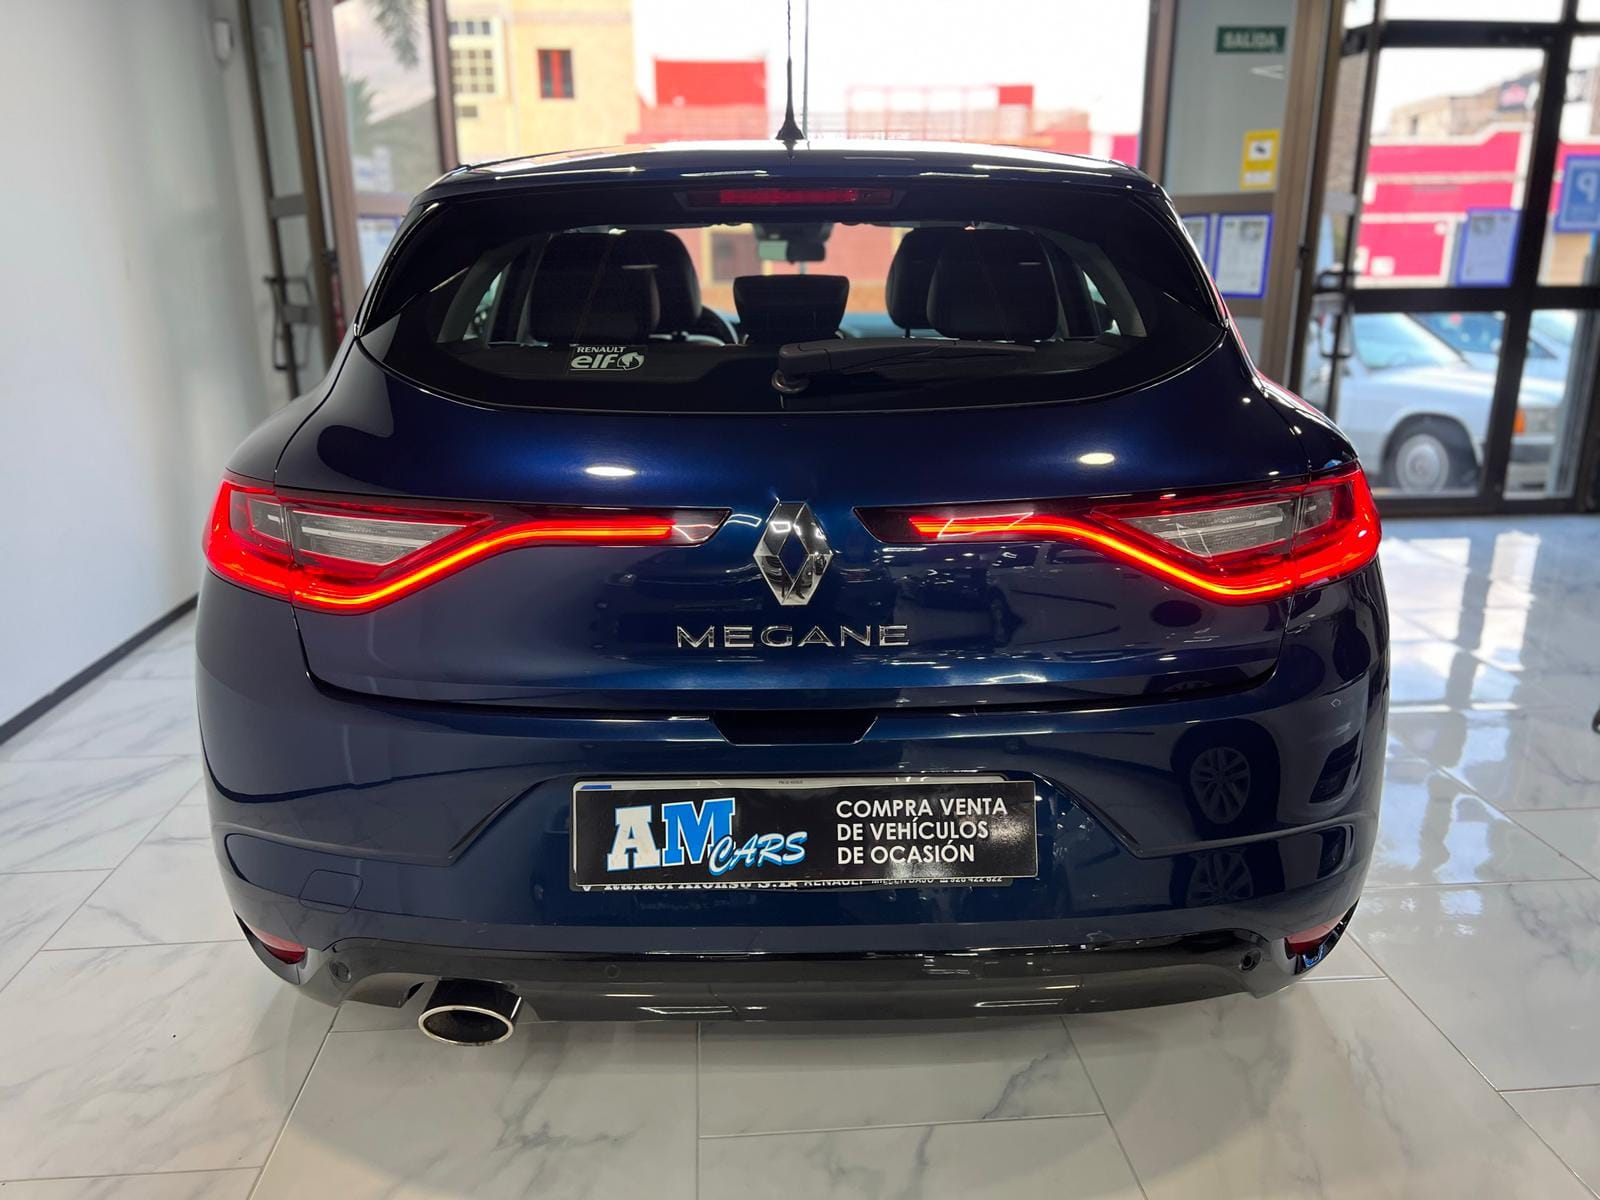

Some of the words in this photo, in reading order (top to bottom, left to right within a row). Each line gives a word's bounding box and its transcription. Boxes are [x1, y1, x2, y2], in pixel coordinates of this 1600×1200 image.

[570, 353, 619, 369] elf
[676, 624, 910, 648] MEGANE
[835, 799, 934, 819] COMPRA
[940, 797, 1009, 816] VENTA
[606, 797, 737, 873] AM
[708, 830, 809, 877] CARS
[837, 822, 865, 841] DE
[869, 815, 990, 841] VEHÍCULOS
[837, 846, 865, 865] DE
[870, 839, 976, 864] OCASIÓN
